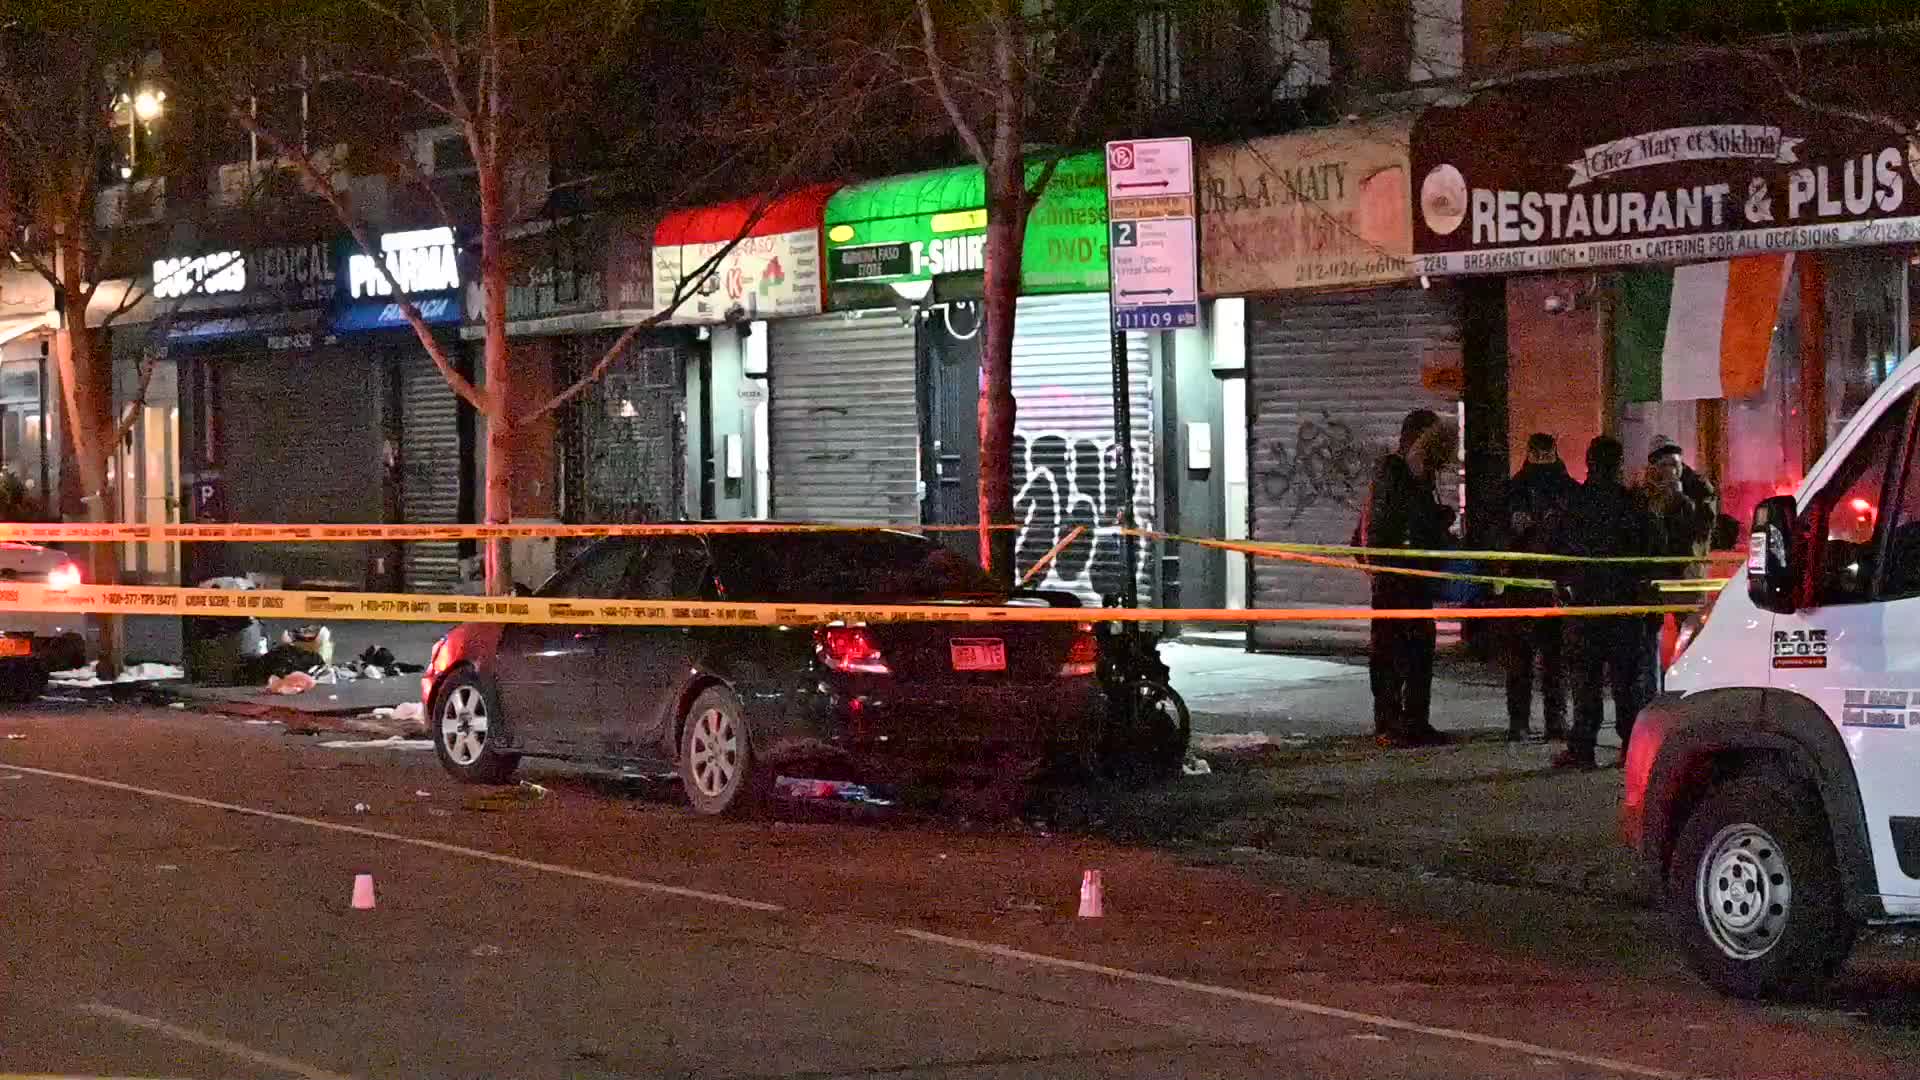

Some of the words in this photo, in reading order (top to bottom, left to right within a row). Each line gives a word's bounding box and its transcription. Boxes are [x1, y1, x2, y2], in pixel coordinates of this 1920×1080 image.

[1591, 146, 1632, 172] Chez
[1687, 131, 1704, 151] et
[1472, 183, 1730, 244] RESTAURANT
[1744, 175, 1775, 224] &
[1788, 147, 1904, 219] PLUS
[1118, 224, 1131, 244] 2
[1464, 251, 1525, 269] BREAKFAST
[1536, 248, 1575, 265] LUNCH
[1588, 243, 1632, 261] DINNER
[1646, 238, 1704, 258] CATERING
[1709, 235, 1734, 252] FOR
[1738, 233, 1760, 249] ALL
[1765, 227, 1840, 249] OCCASIONS
